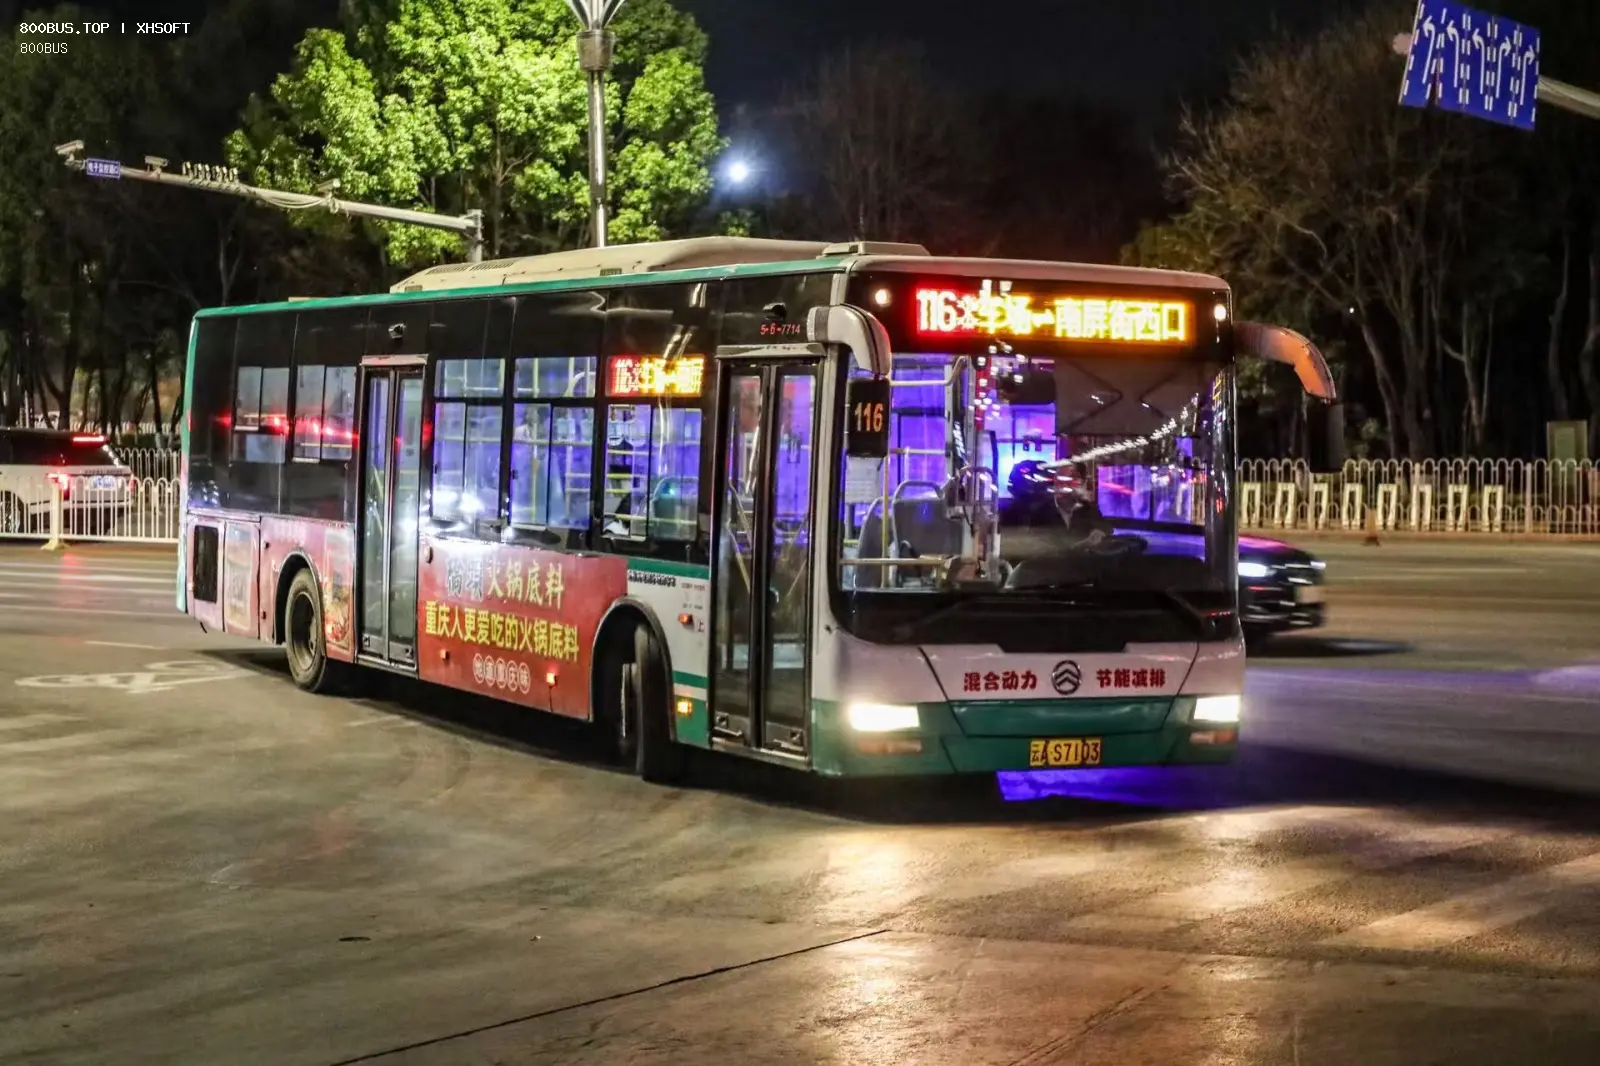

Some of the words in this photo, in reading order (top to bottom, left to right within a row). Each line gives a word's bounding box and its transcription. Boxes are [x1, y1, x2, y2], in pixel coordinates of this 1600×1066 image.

[854, 402, 884, 432] 116
[425, 600, 580, 662] 重庆人更爱吃的火锅底料
[963, 671, 1038, 692] 混合动力
[1096, 668, 1166, 689] 节能减排
